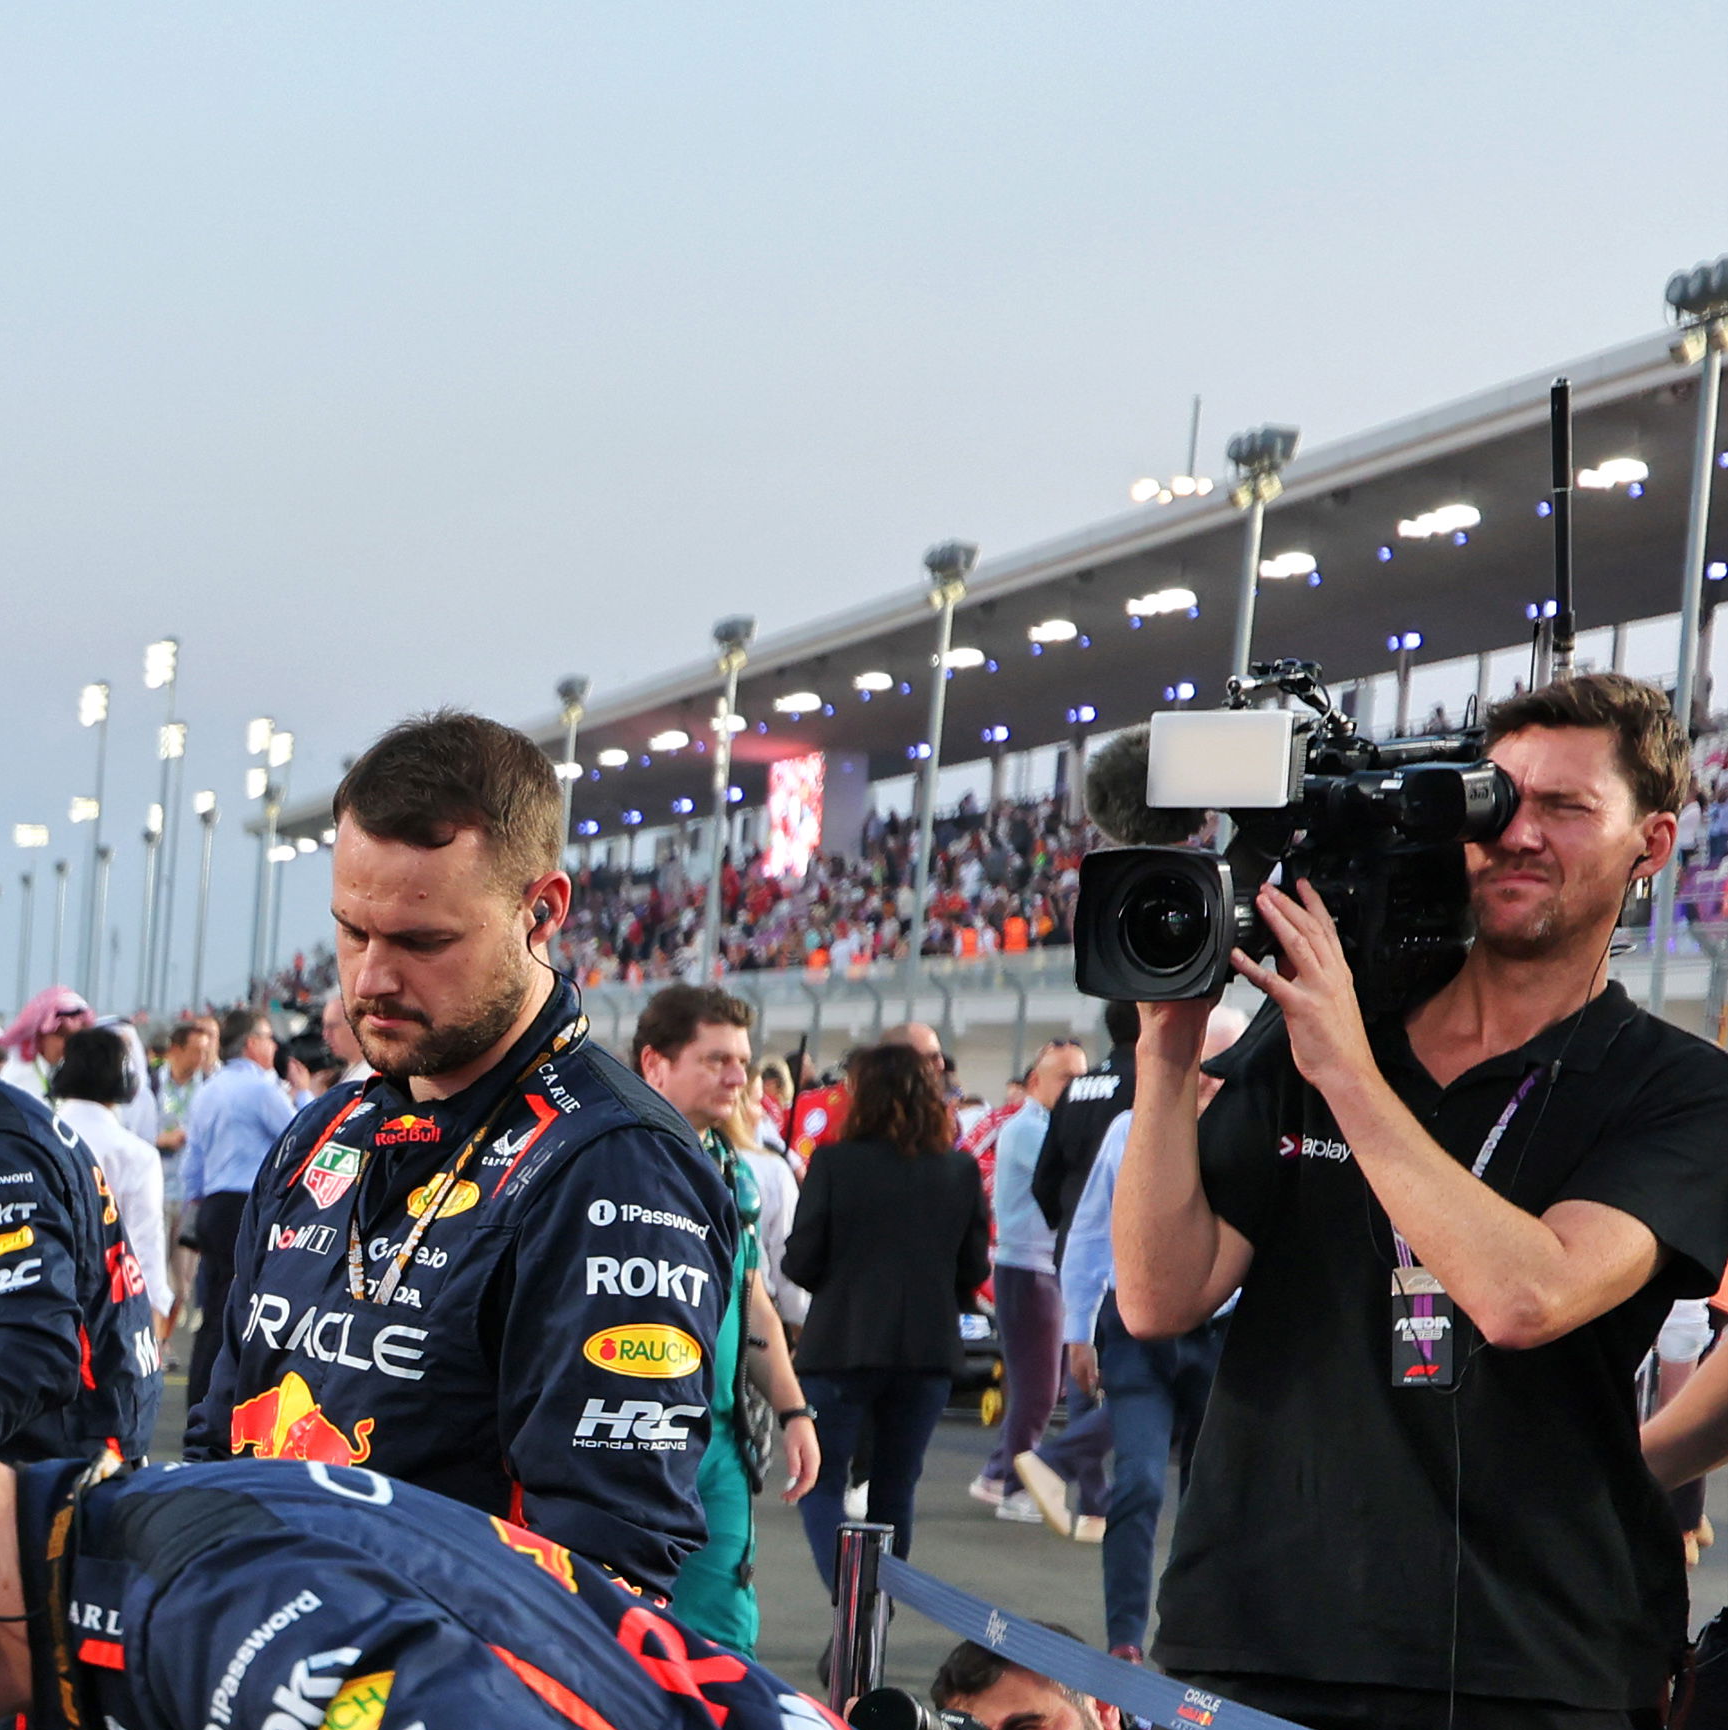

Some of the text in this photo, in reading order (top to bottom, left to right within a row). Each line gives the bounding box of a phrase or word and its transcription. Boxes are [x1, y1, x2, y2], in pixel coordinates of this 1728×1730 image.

[620, 1204, 710, 1242] 1Password
[585, 1255, 709, 1309] ROKT
[618, 1340, 692, 1363] RAUCH
[574, 1399, 706, 1438] HRC
[572, 1438, 688, 1452] Honda RACING
[1184, 1688, 1222, 1713] ORACLE
